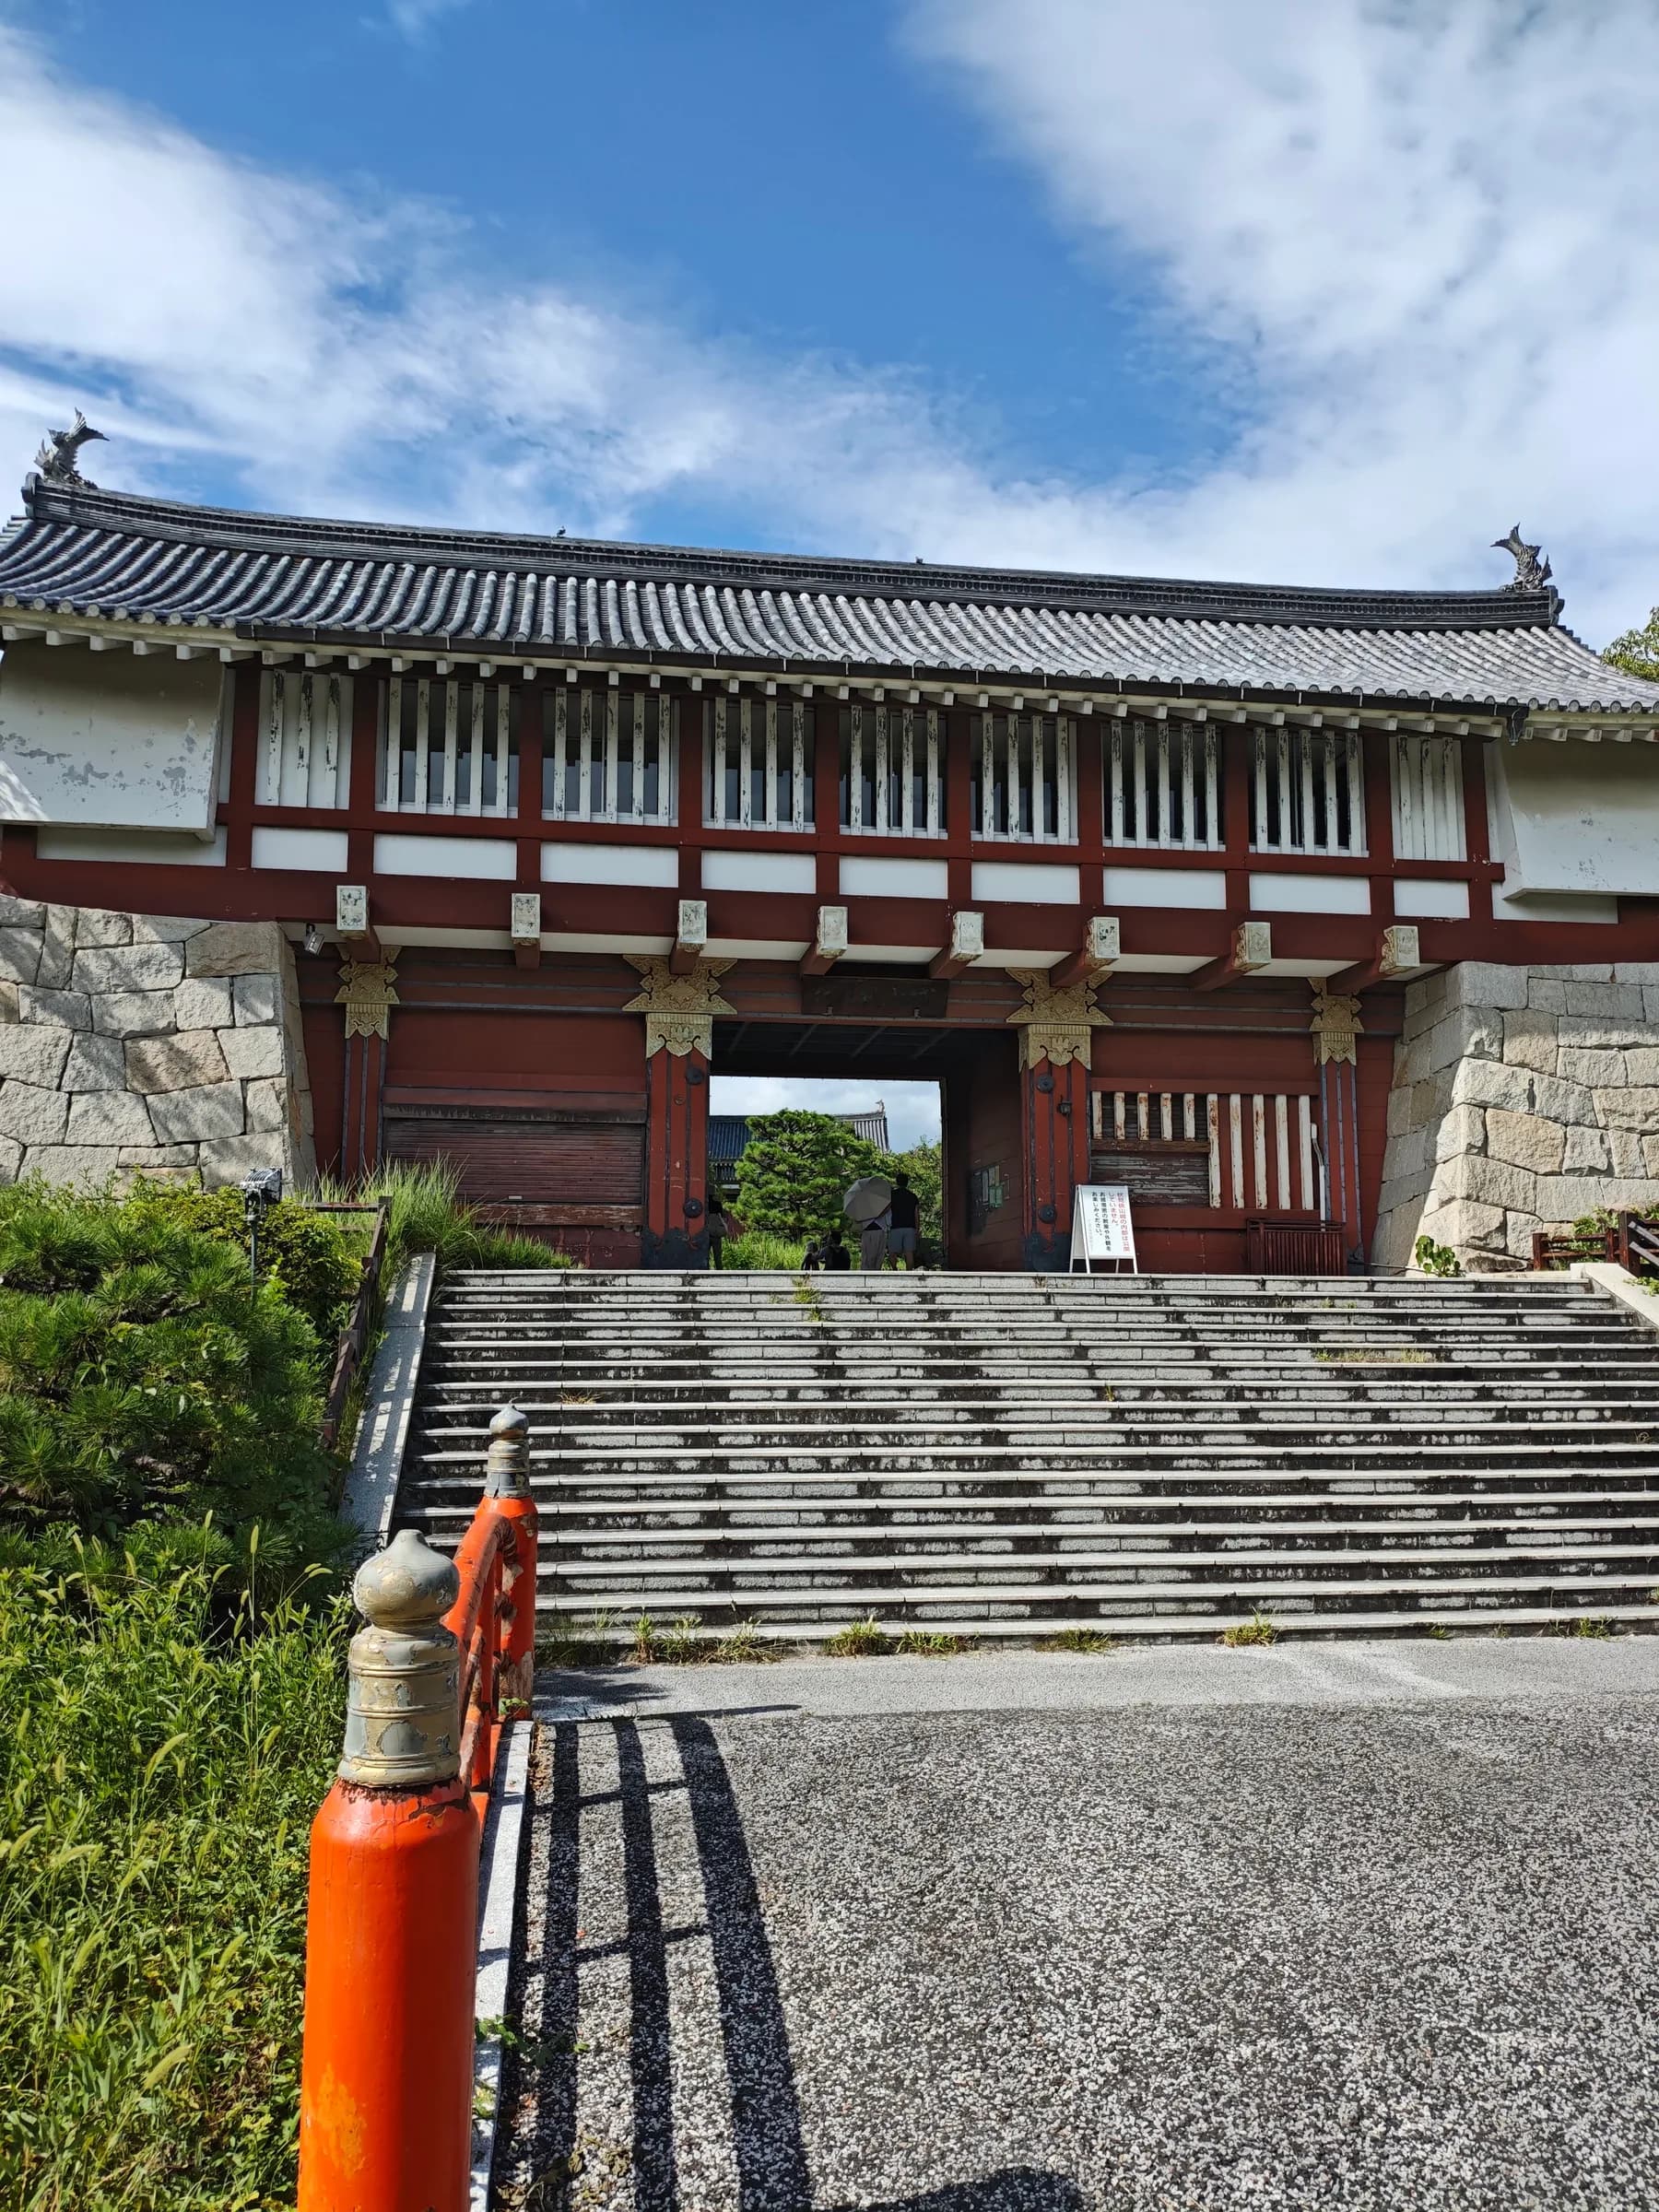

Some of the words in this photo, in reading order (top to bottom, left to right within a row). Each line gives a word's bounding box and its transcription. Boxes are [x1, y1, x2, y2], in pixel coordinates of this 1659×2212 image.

[1092, 1192, 1102, 1236] お楽しみください。
[1109, 1192, 1119, 1226] していません。
